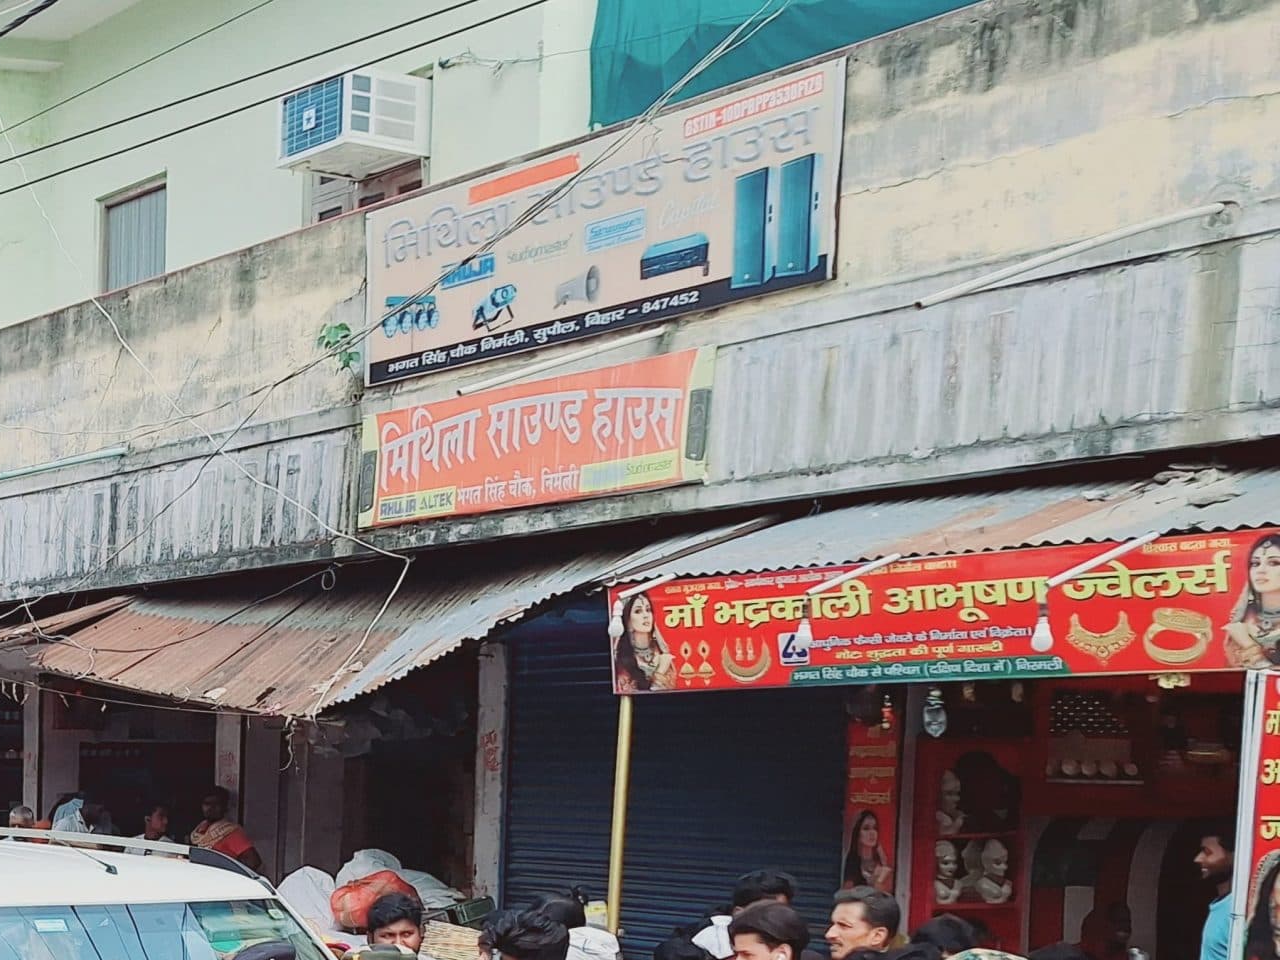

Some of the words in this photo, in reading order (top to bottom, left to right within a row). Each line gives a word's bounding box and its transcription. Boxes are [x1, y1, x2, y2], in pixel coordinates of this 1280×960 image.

[386, 356, 419, 373] भगत
[421, 350, 446, 367] सिंह
[641, 290, 701, 314] 847452
[381, 408, 484, 491] मिथिला
[486, 389, 588, 459] साउण्ड
[592, 387, 683, 452] हाउस
[484, 474, 506, 501] सिंह
[664, 592, 709, 628] माँ
[714, 579, 872, 629] भद्रकाली
[883, 576, 1049, 623] आभूषण
[1062, 549, 1232, 601] ज्वेलर्स
[793, 670, 821, 682] भगत
[822, 667, 844, 681] सिंह
